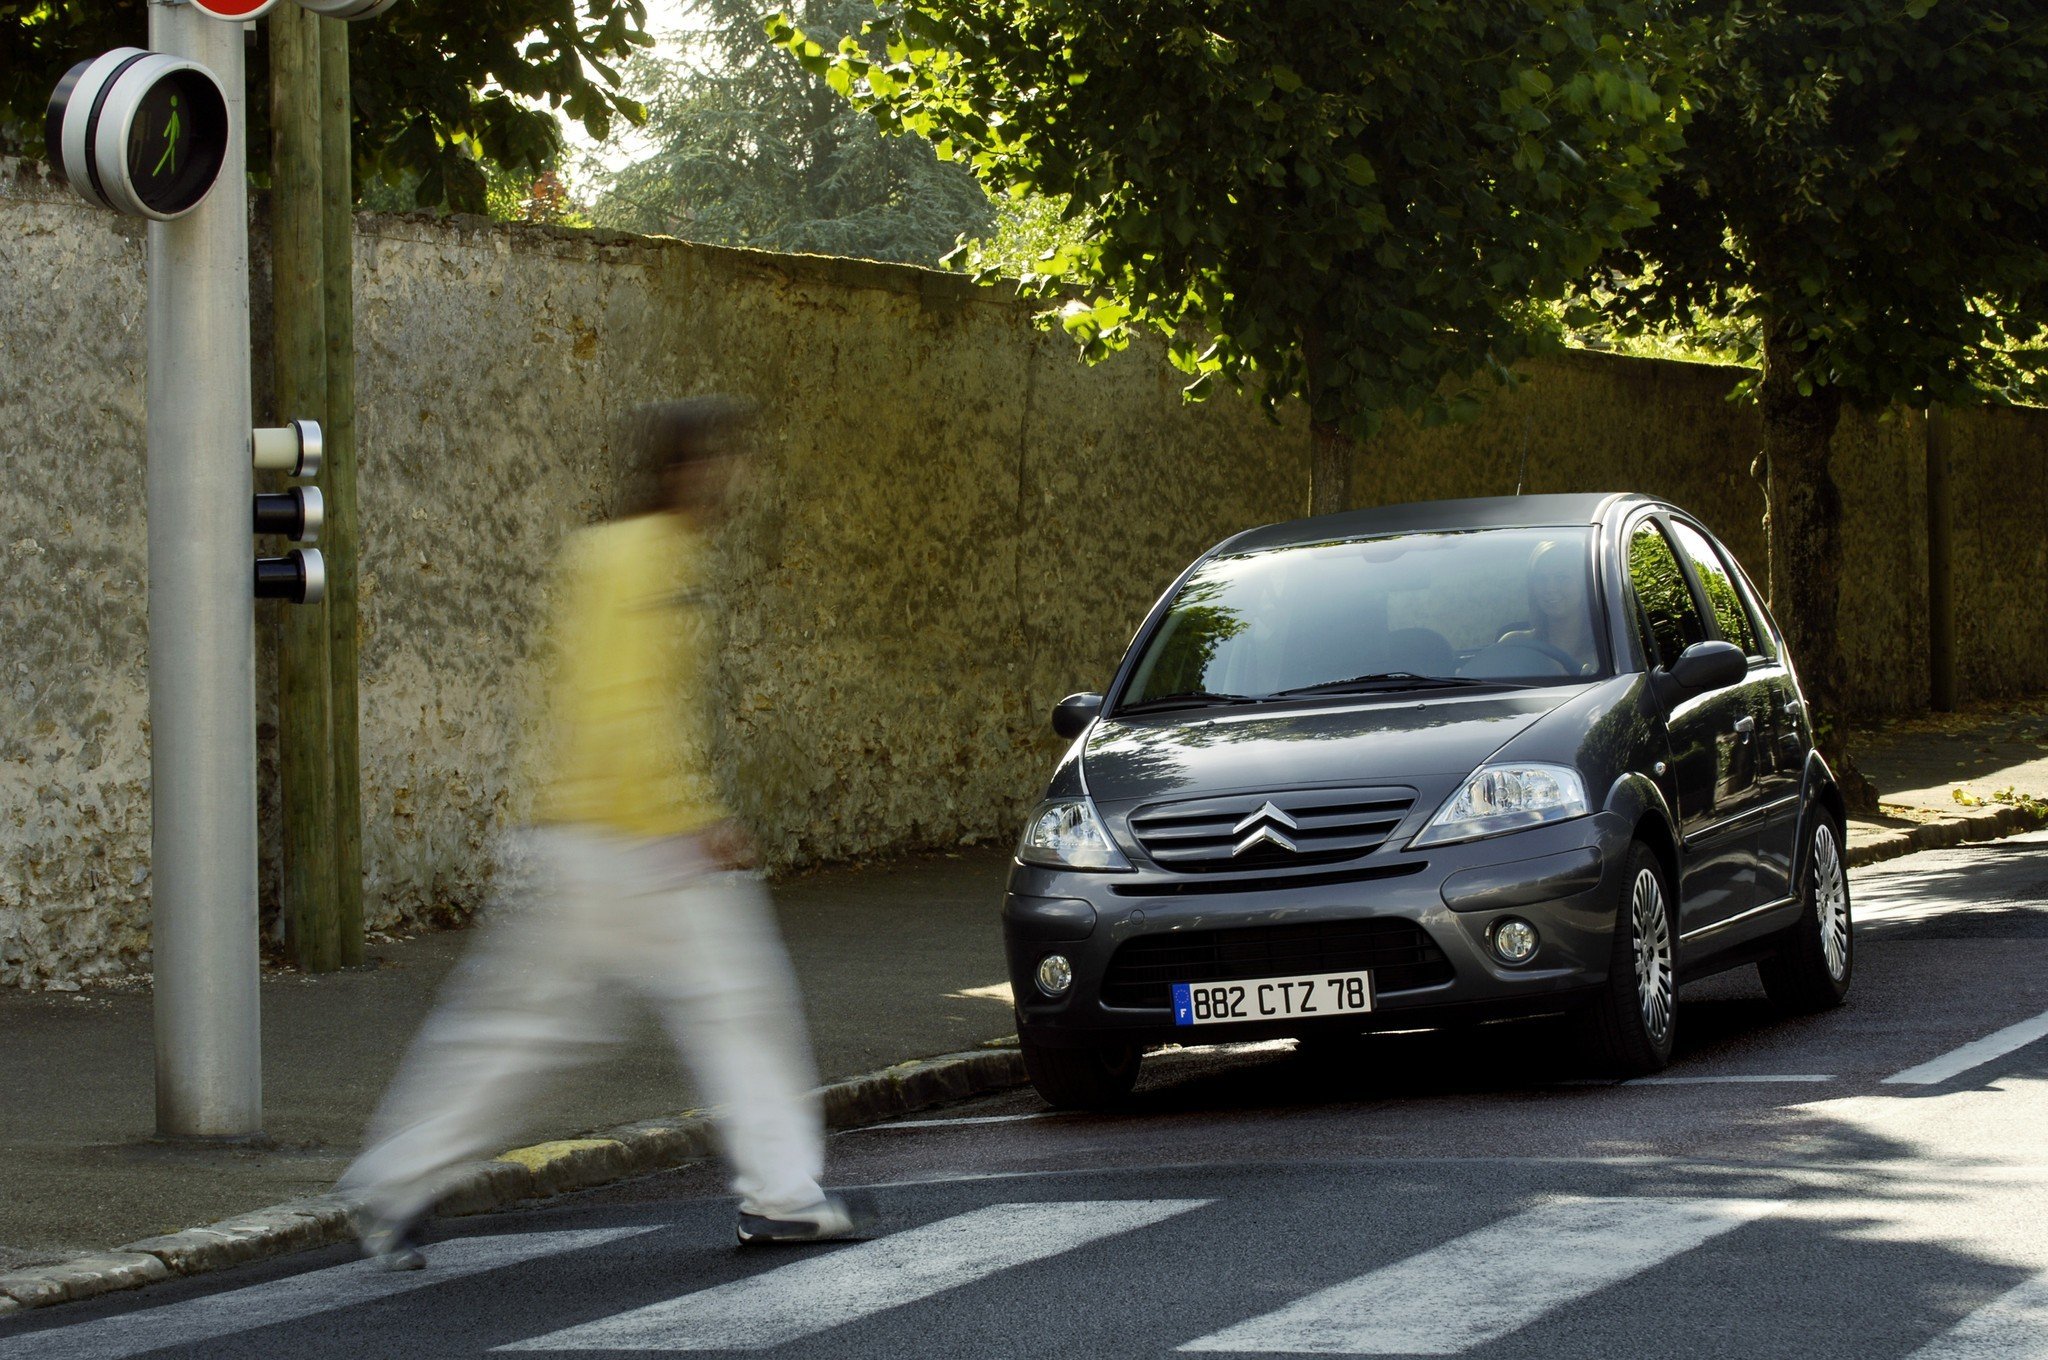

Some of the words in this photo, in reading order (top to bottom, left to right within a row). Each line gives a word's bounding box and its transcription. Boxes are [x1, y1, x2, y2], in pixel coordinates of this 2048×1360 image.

[1194, 986, 1247, 1019] 882
[1258, 981, 1317, 1015] CTZ
[1328, 977, 1365, 1009] 78
[1180, 1008, 1187, 1018] F
